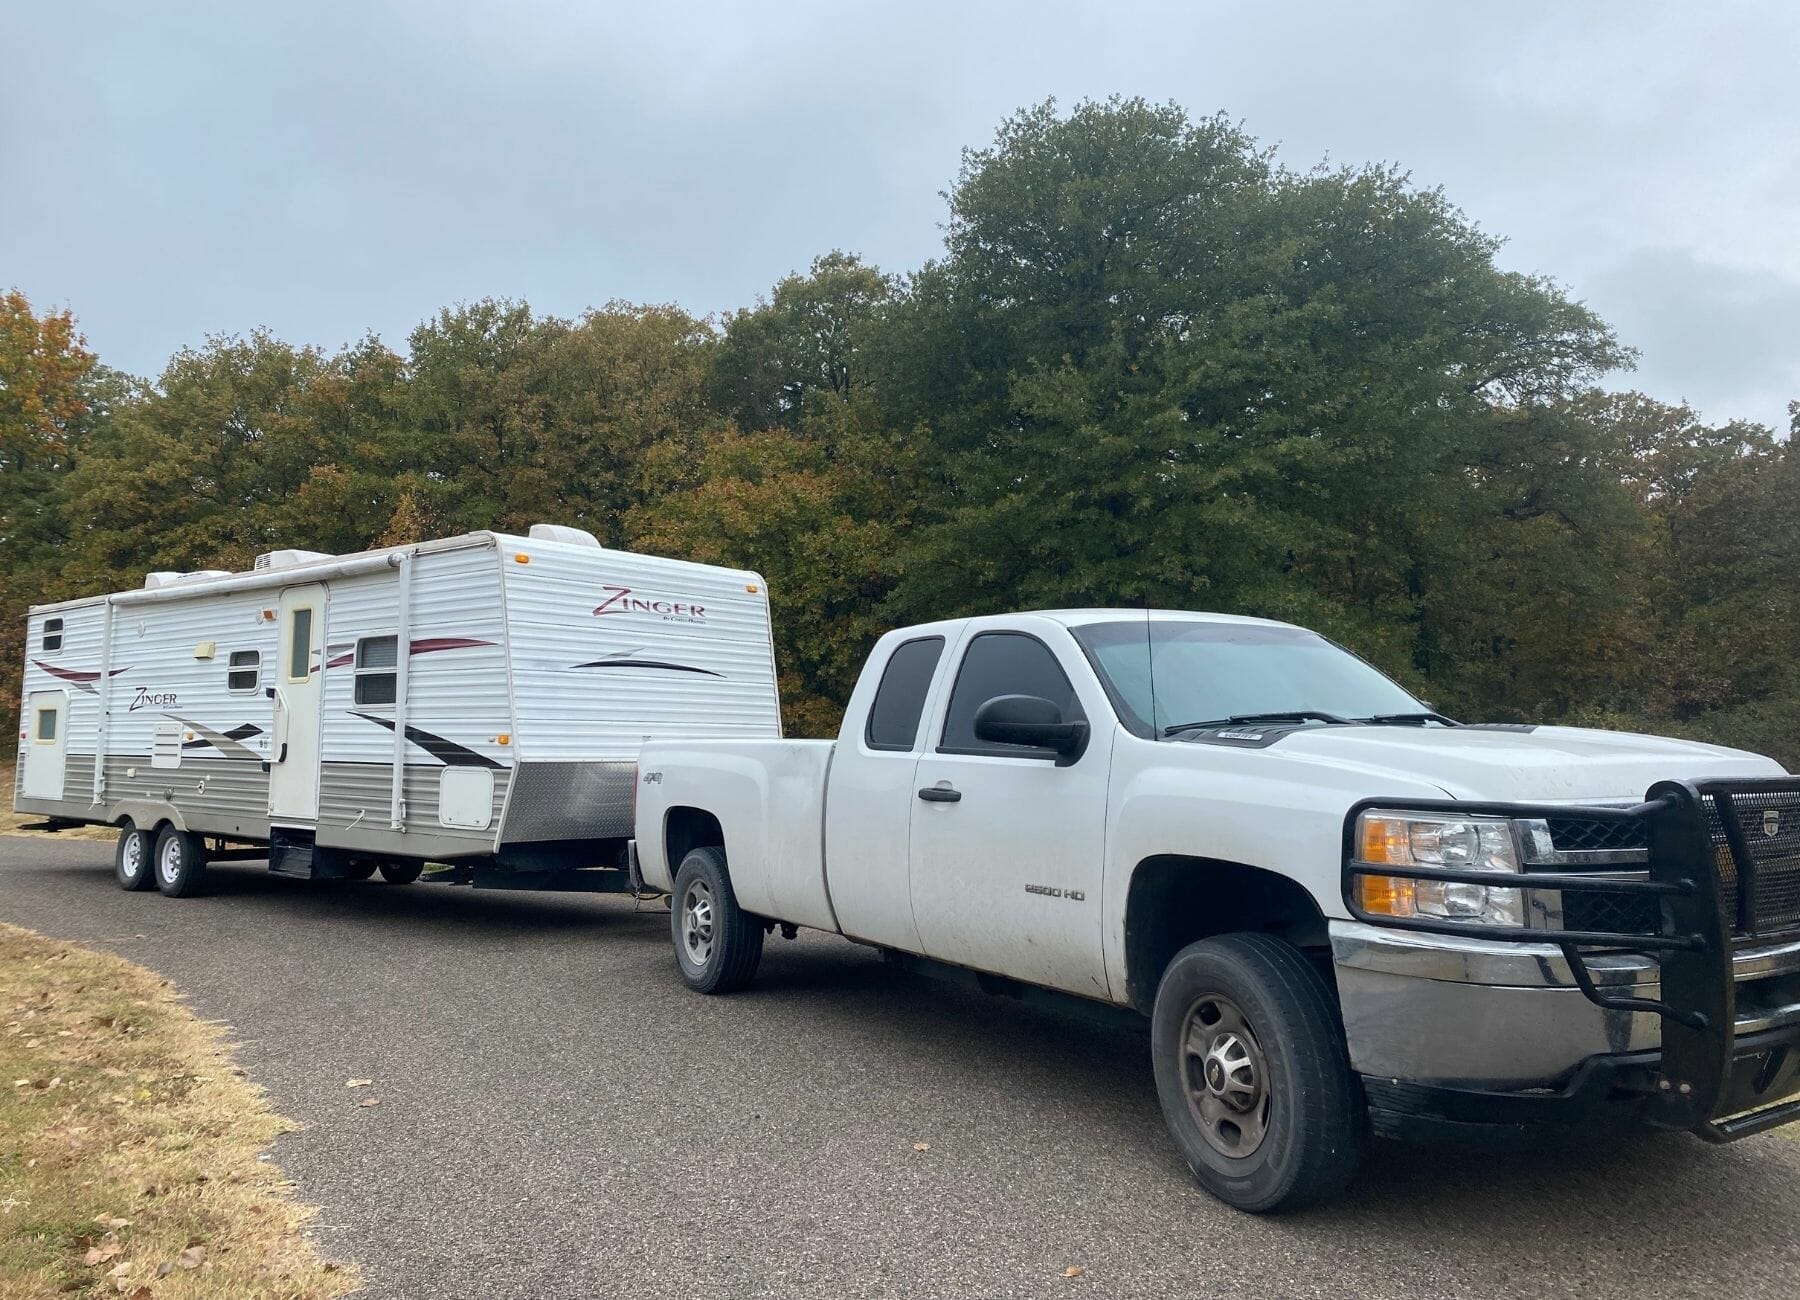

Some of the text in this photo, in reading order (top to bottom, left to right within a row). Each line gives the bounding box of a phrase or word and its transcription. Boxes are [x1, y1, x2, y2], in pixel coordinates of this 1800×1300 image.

[592, 586, 706, 617] ZINGER
[1025, 884, 1085, 901] 2500 HD
